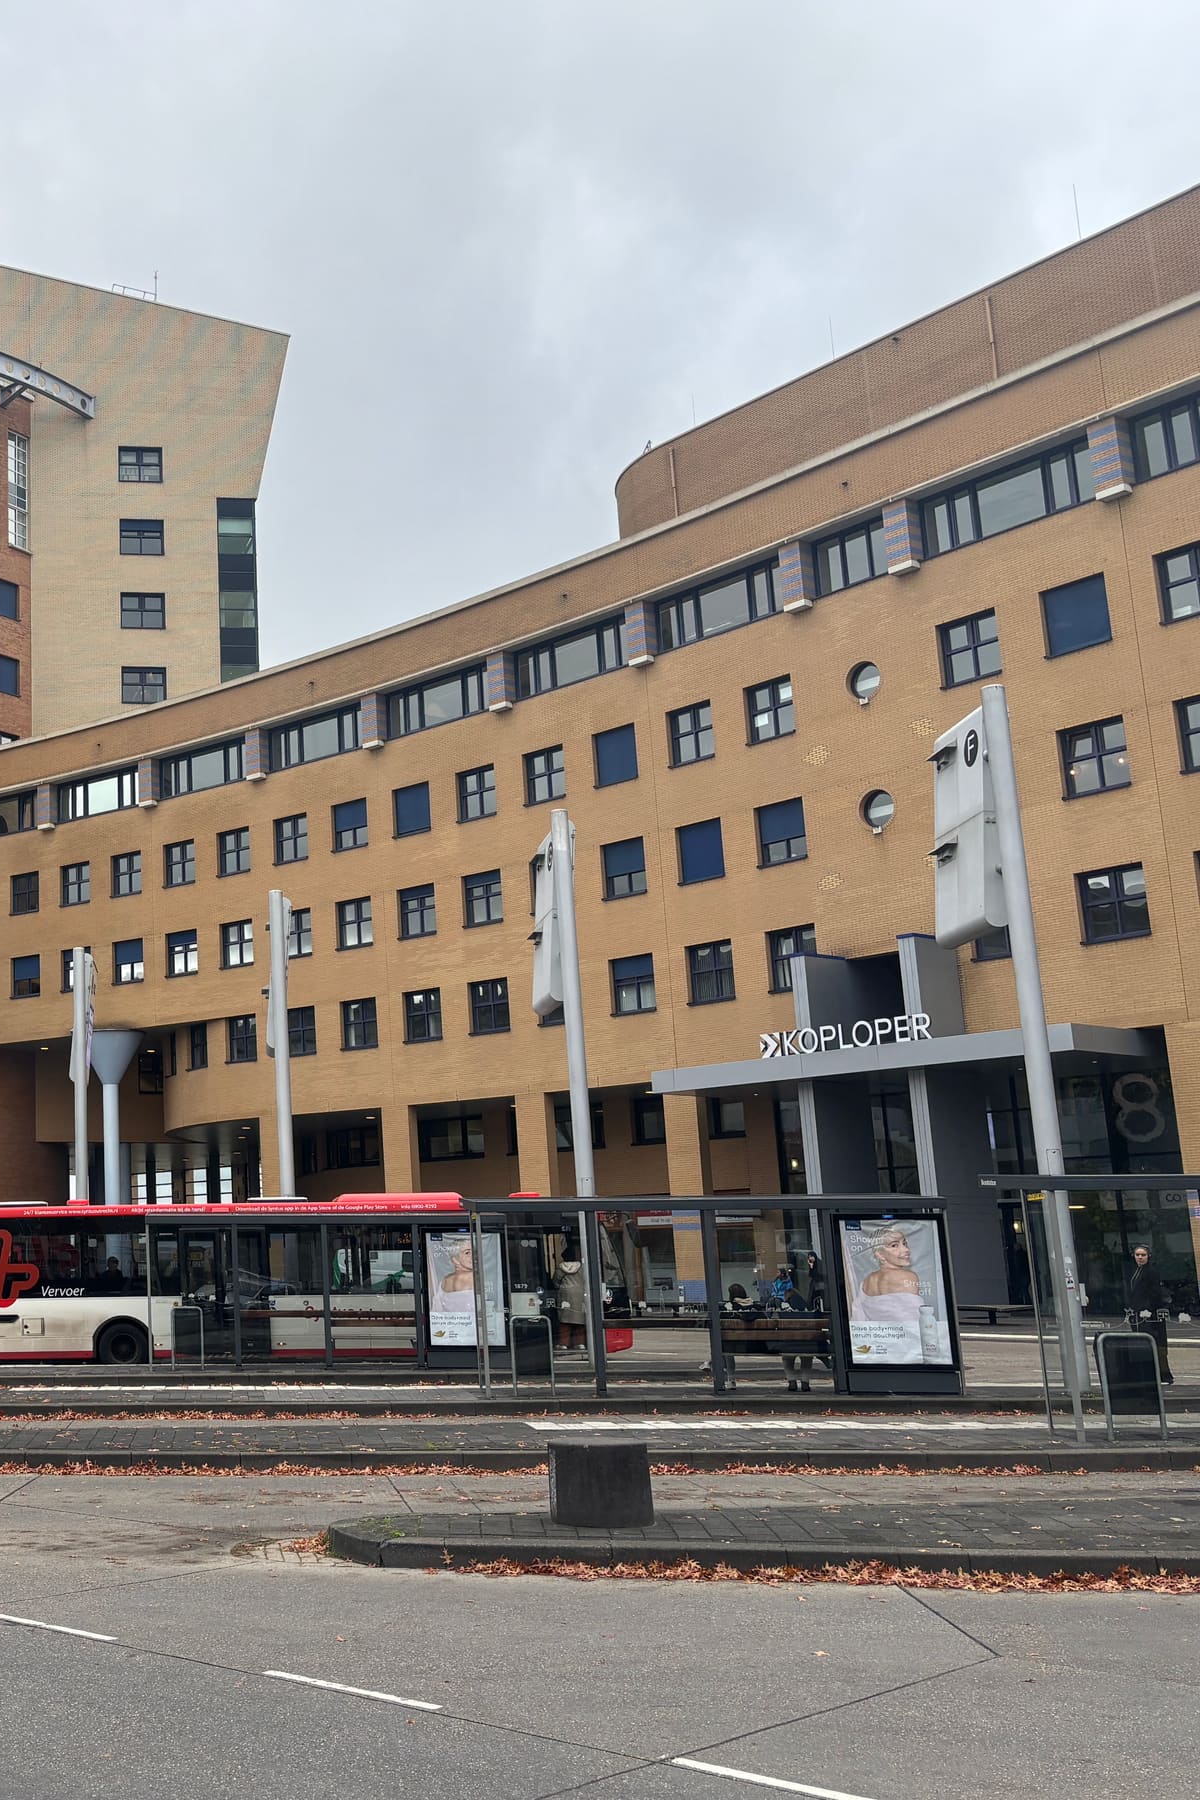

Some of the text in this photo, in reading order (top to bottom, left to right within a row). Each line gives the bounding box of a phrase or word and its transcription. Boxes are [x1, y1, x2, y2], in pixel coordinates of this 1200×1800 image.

[967, 733, 975, 762] F
[783, 1012, 932, 1056] KOPLOPER
[1112, 1072, 1166, 1142] 8
[40, 1286, 85, 1297] Vervoer
